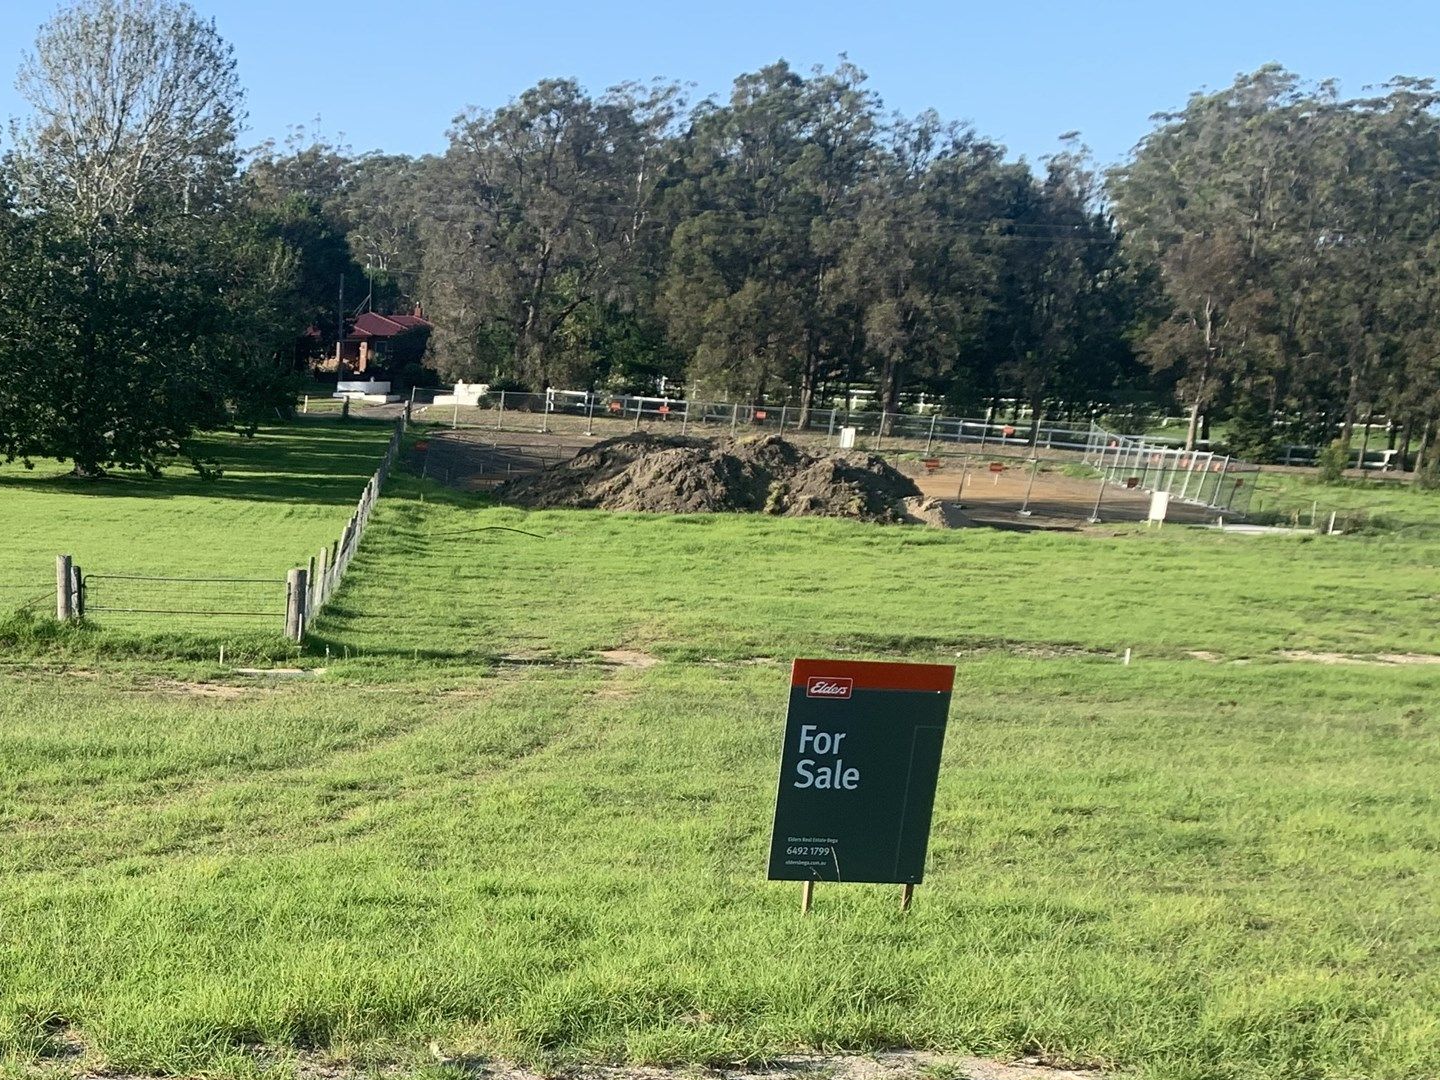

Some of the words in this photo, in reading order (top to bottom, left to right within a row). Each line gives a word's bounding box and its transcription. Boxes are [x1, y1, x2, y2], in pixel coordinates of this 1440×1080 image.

[811, 681, 848, 694] Elders
[798, 724, 846, 755] For
[793, 759, 860, 790] Sale
[786, 846, 809, 855] 6492
[809, 847, 830, 856] 1799
